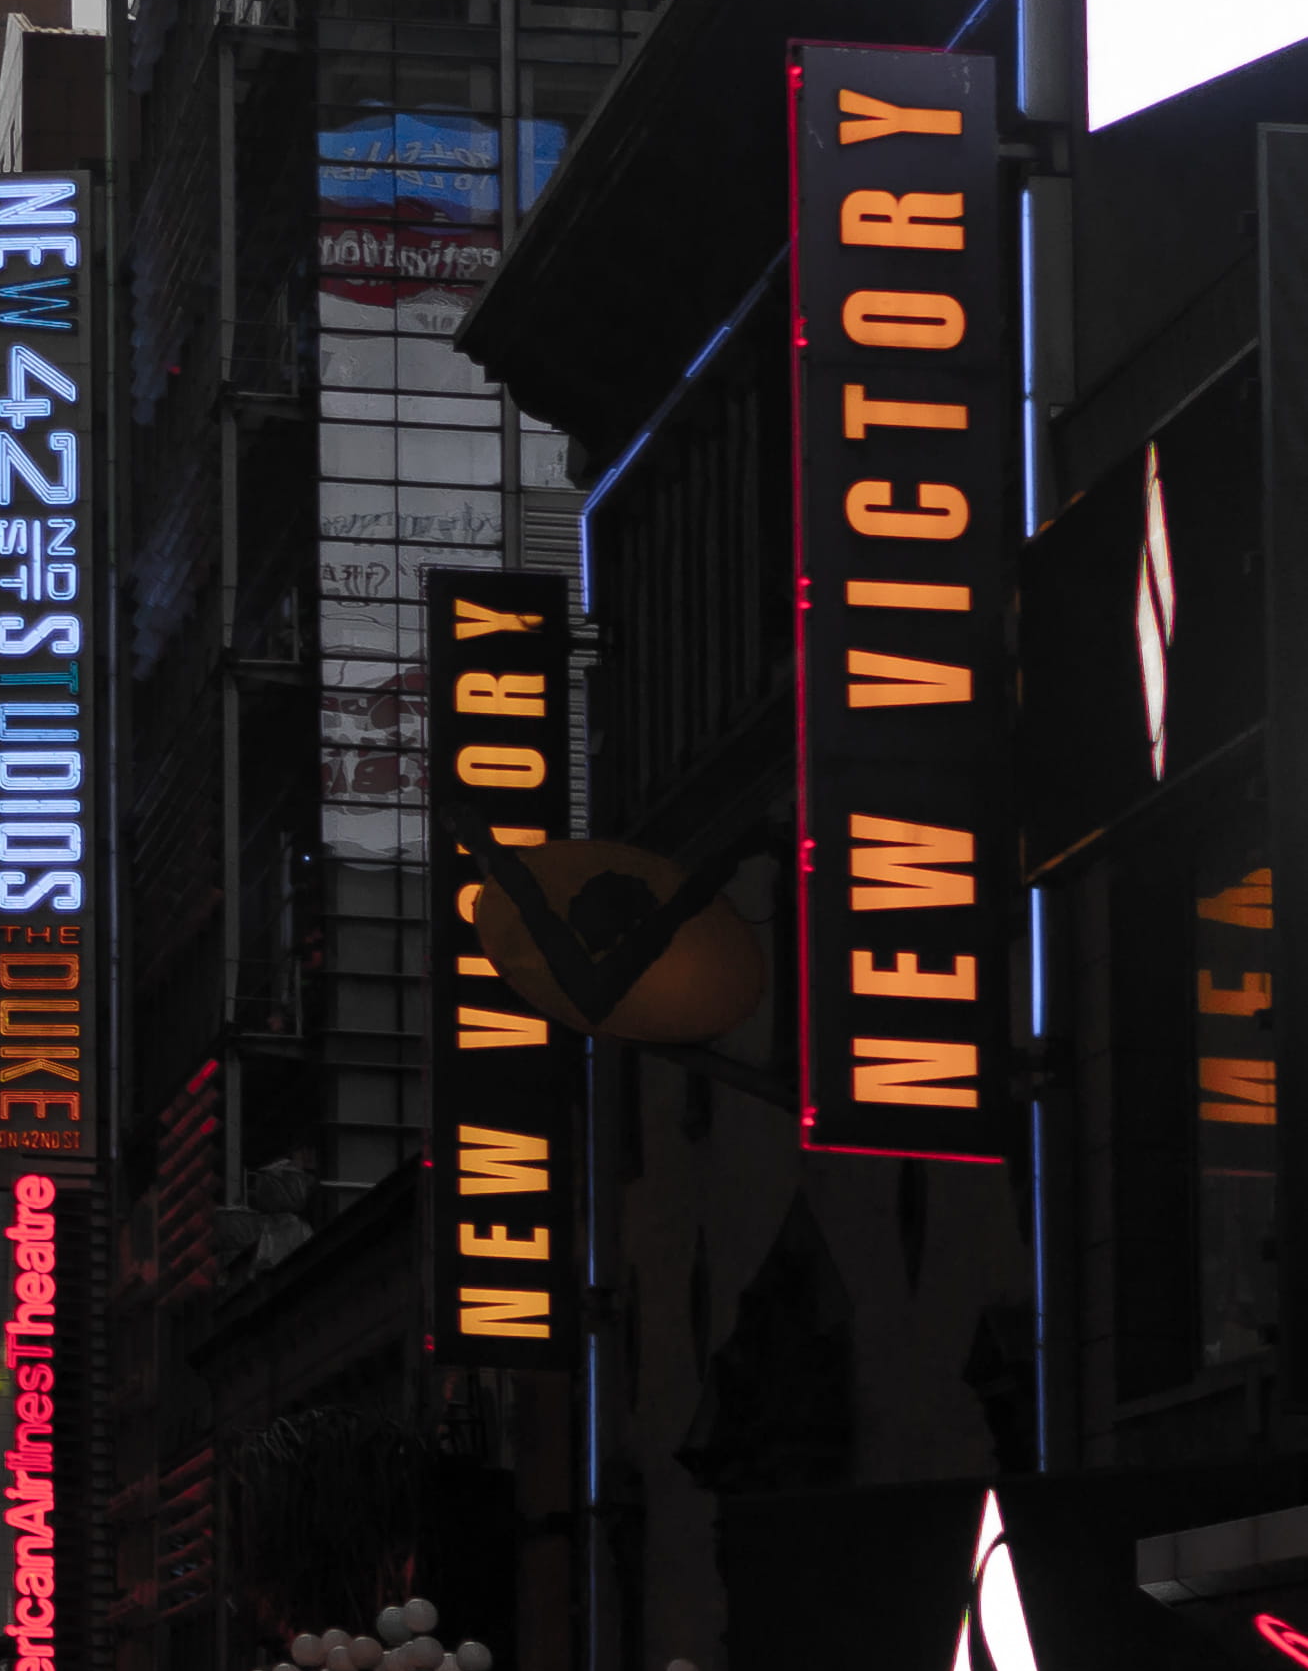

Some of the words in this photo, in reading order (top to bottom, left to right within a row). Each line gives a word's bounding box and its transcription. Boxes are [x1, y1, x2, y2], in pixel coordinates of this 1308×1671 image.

[838, 88, 973, 712] VICTORY
[453, 598, 550, 1050] VORY
[850, 812, 980, 1110] NEW
[457, 1124, 551, 1339] NEW
